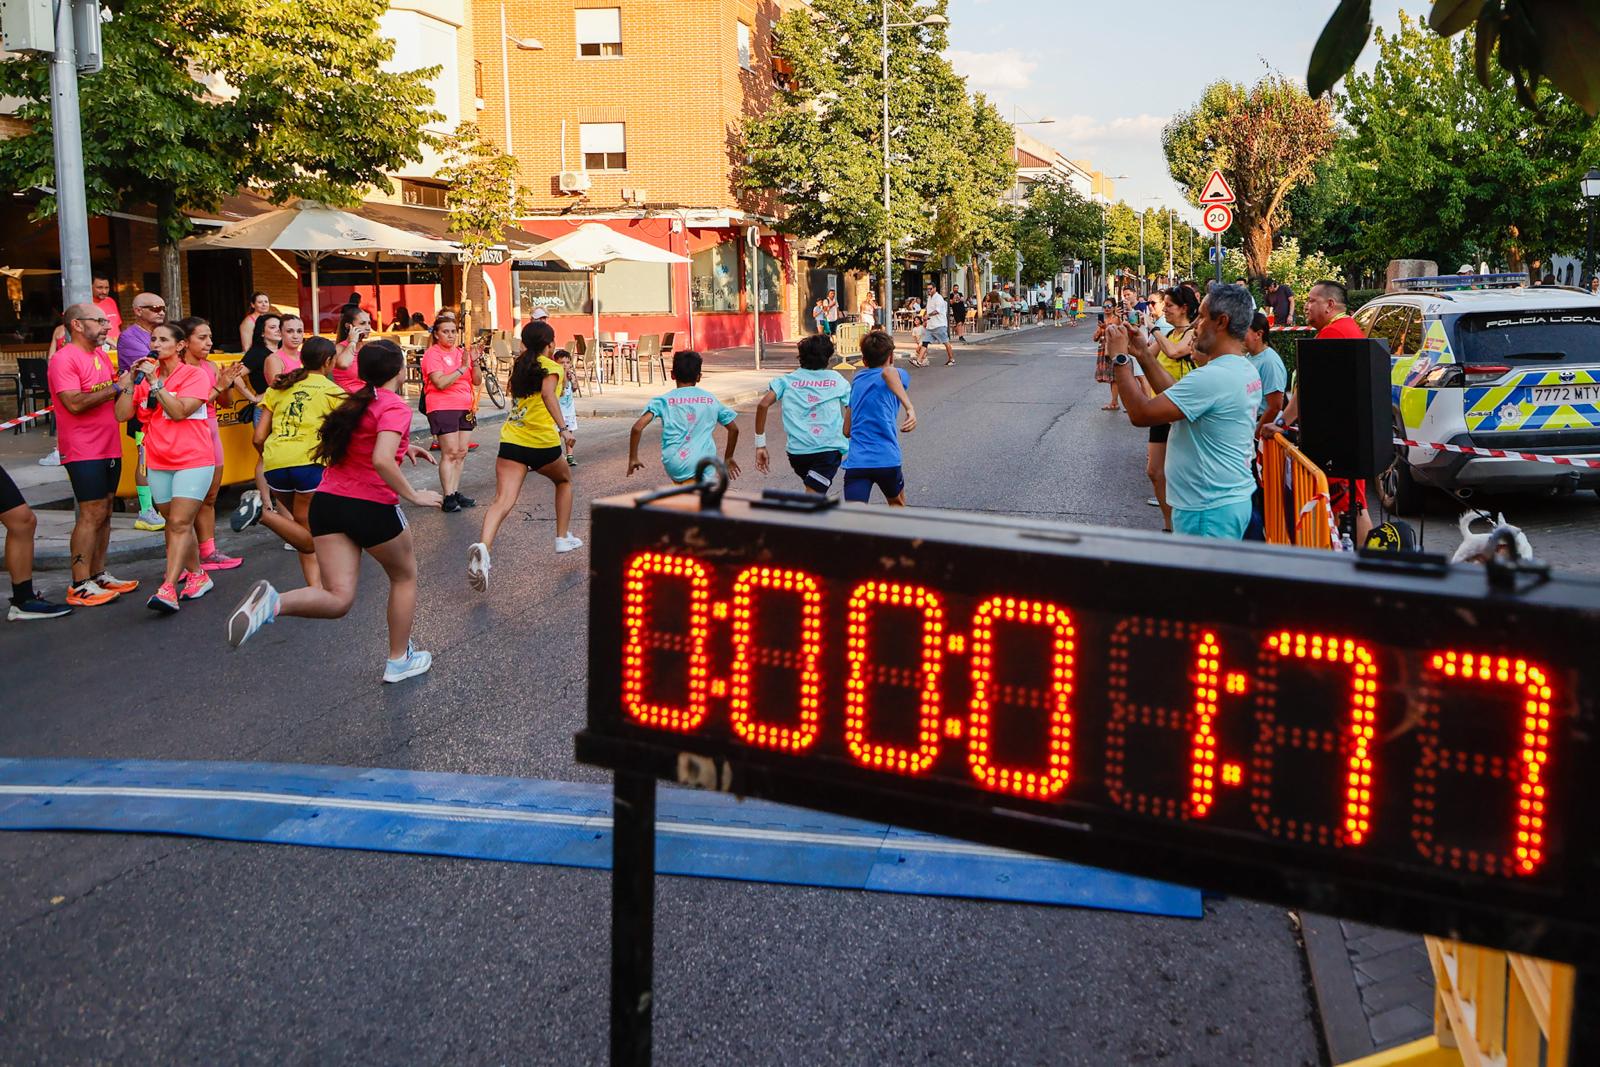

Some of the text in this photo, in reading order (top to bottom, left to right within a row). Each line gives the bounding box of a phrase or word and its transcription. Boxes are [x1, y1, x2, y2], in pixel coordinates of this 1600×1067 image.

[1210, 213, 1225, 223] 20
[1550, 315, 1600, 323] LOCAL
[791, 380, 837, 388] RUNNER
[1535, 386, 1600, 402] 7772 MTY
[668, 396, 714, 406] RUNNER
